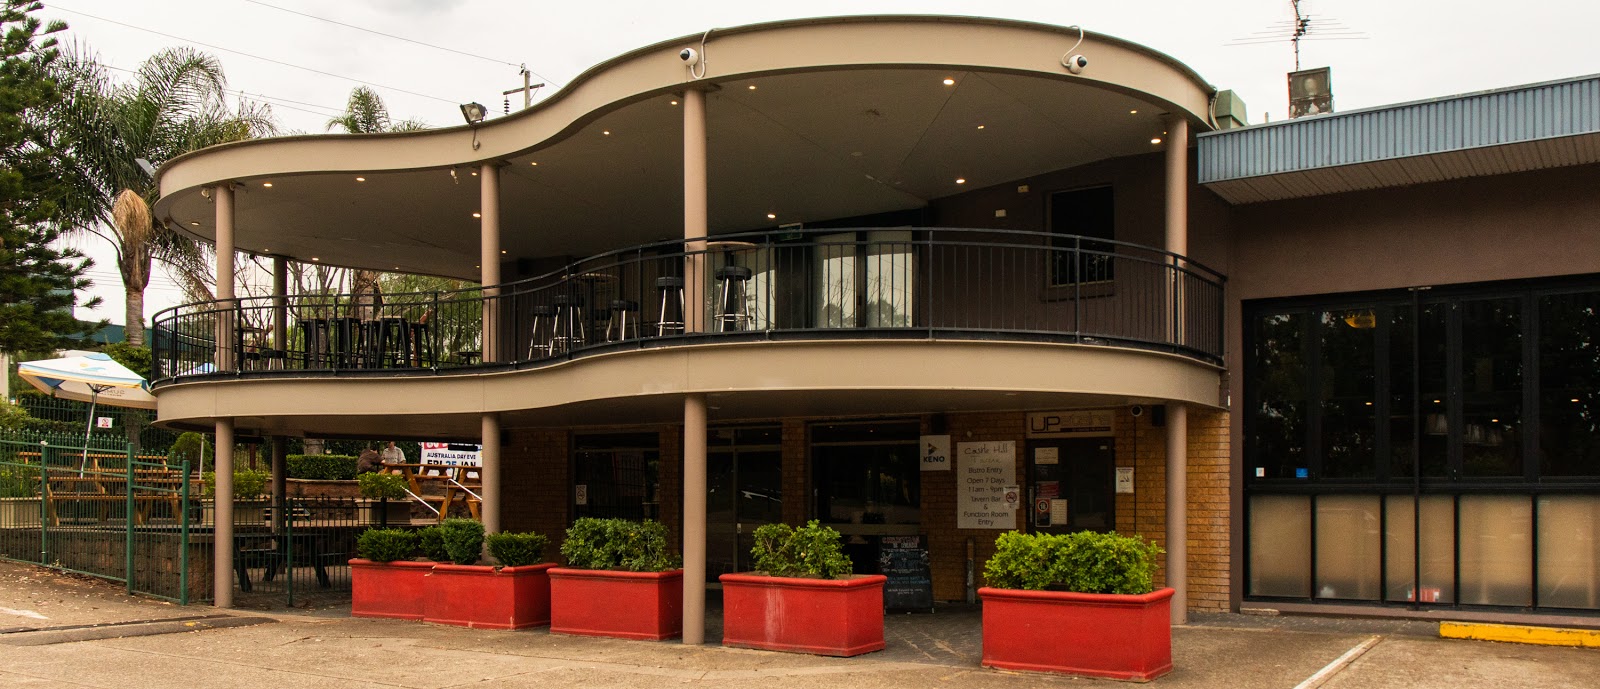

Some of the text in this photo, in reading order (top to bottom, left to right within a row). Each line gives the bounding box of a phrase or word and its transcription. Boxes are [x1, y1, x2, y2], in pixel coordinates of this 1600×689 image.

[1031, 416, 1060, 431] UP
[965, 443, 1008, 454] Castle Hill
[987, 466, 1003, 474] Entry
[967, 477, 984, 485] Open
[991, 477, 1006, 485] Days
